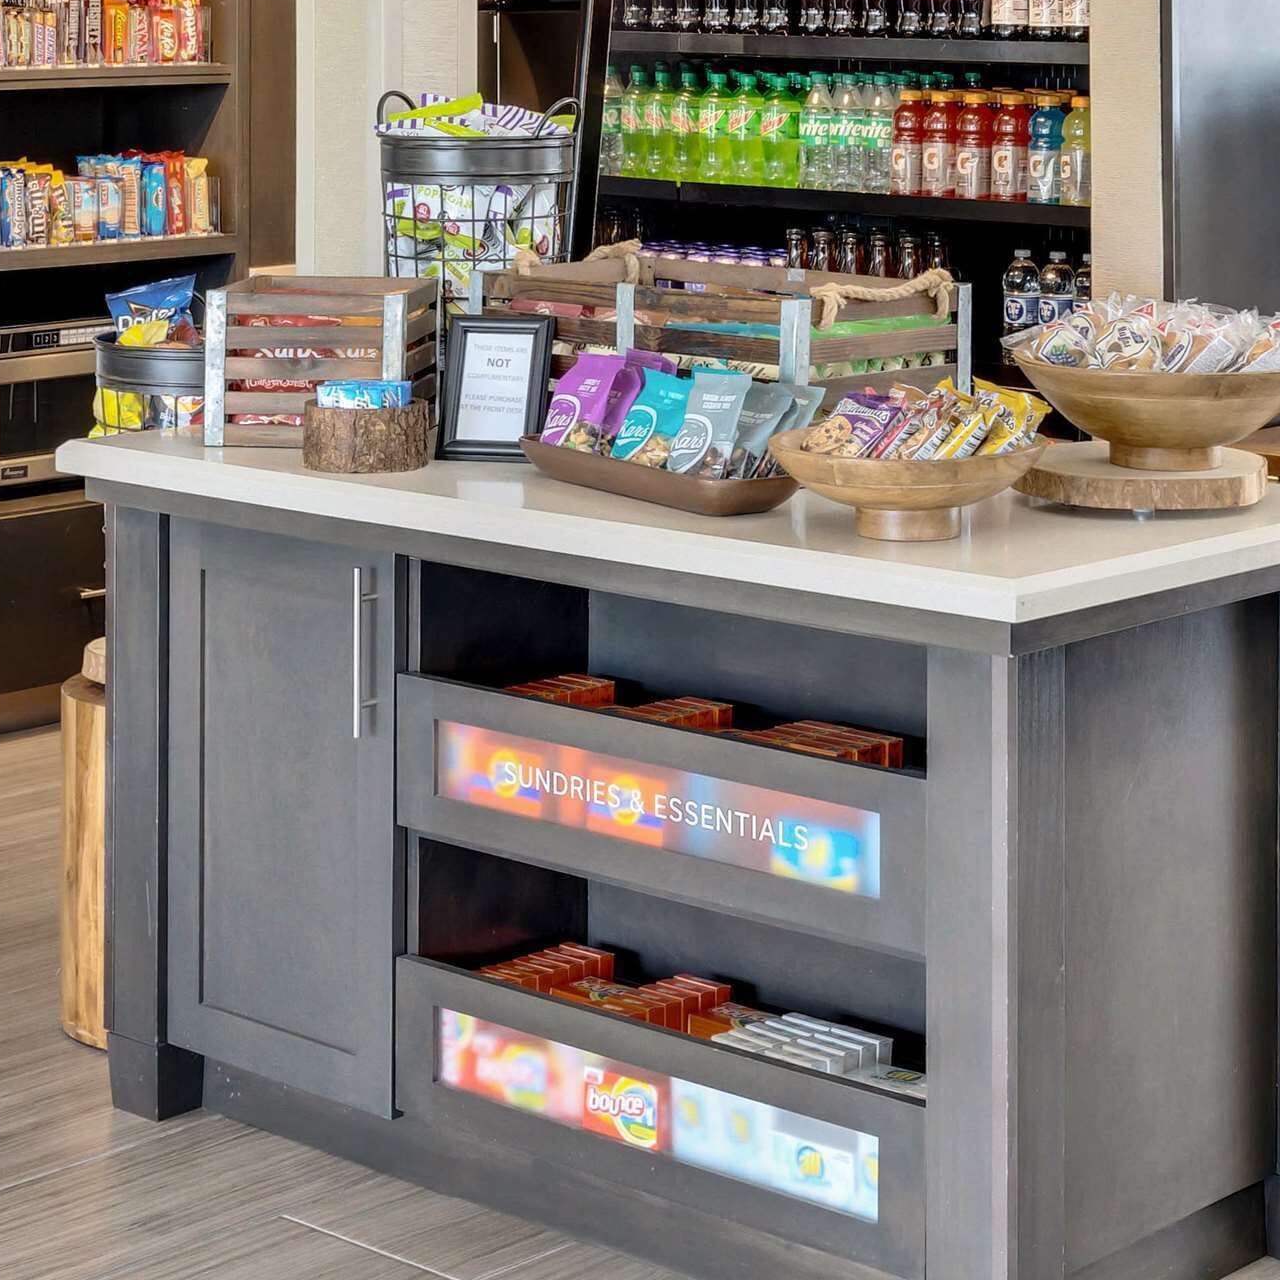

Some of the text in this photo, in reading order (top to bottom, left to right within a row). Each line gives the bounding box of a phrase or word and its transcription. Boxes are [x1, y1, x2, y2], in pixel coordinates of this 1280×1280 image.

[486, 357, 512, 368] NOT
[504, 761, 809, 851] SUNDRIES & ESSENTIALS
[588, 1086, 645, 1117] bounce
